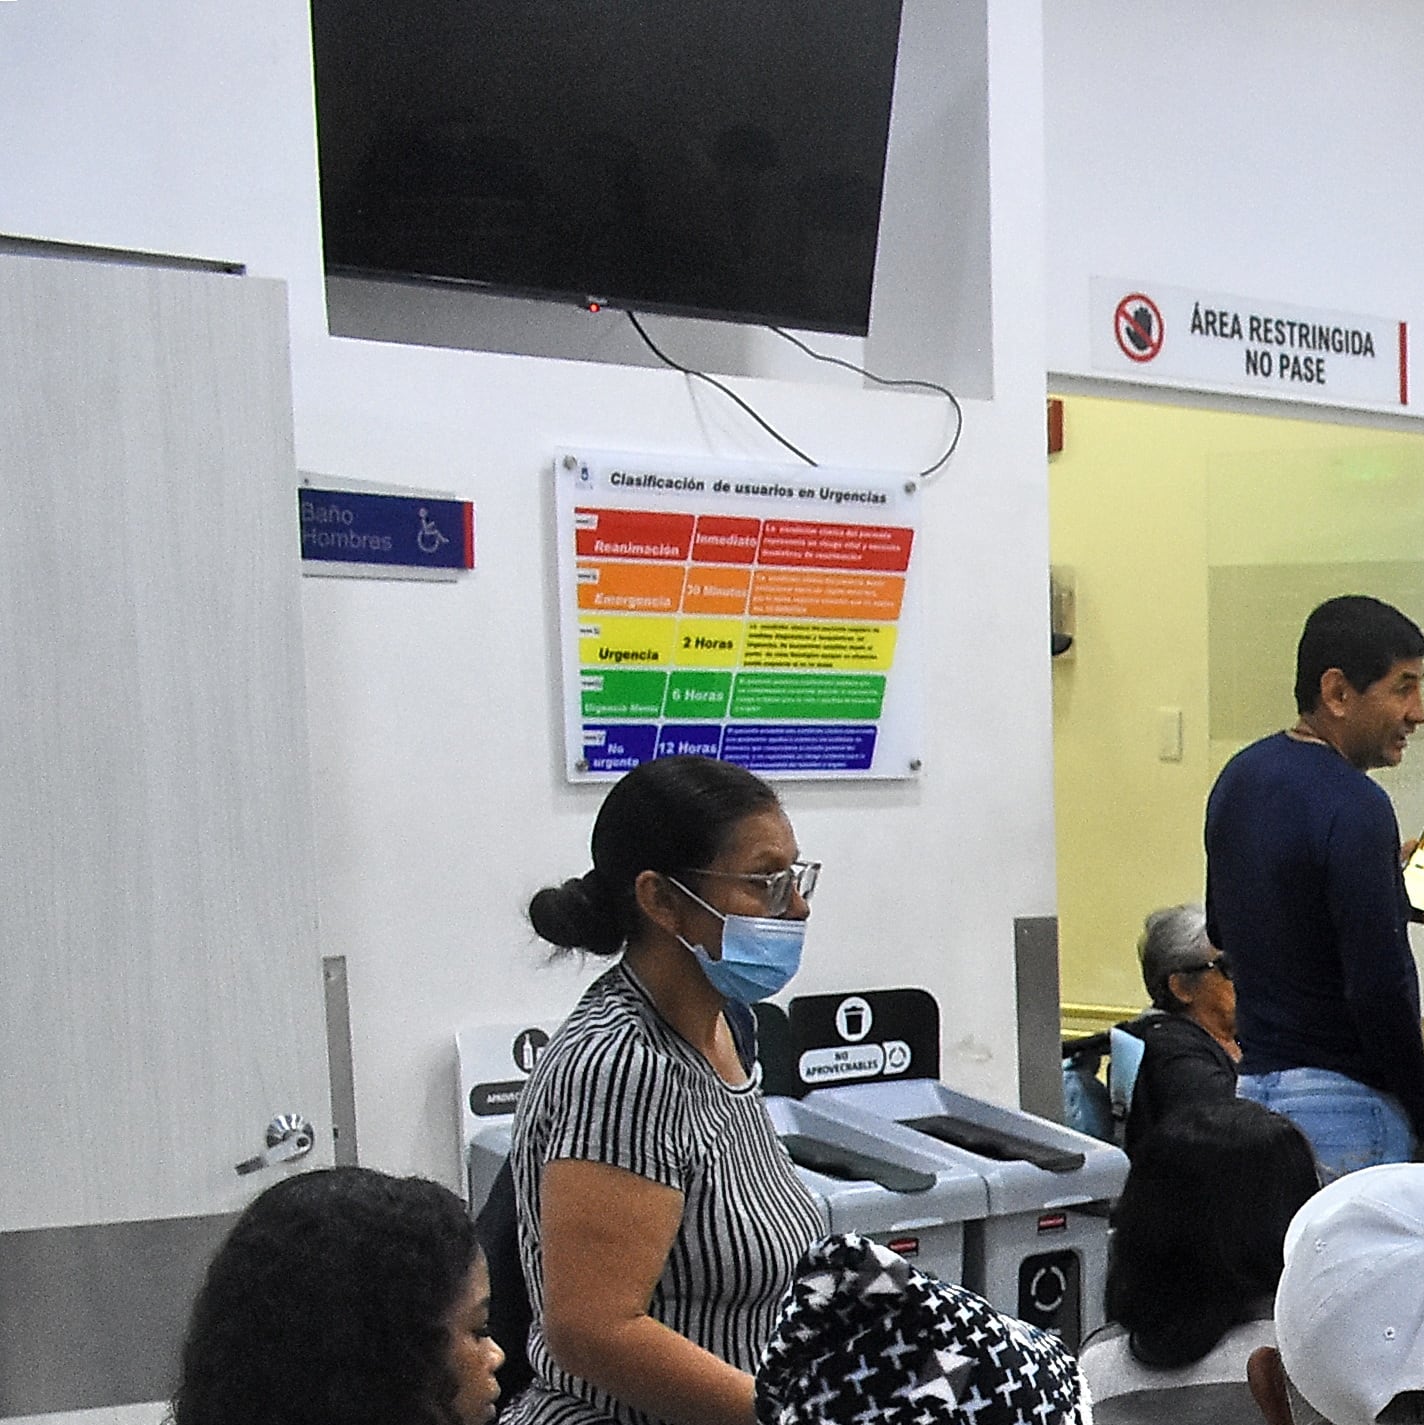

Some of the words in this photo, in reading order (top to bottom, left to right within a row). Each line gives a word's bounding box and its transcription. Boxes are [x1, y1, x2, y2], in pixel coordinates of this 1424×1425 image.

[1190, 300, 1243, 341] ÁREA
[1248, 314, 1376, 358] RESTRINGIDA
[1244, 349, 1273, 379] NO
[1278, 353, 1326, 384] PASE
[610, 471, 705, 492] Clasificación
[713, 479, 730, 493] de
[734, 482, 794, 498] usuarios
[798, 489, 815, 499] en
[819, 487, 888, 504] Urgencias
[301, 501, 354, 526] Baño
[302, 527, 393, 551] Hombres
[695, 533, 757, 548] Inmediato
[593, 539, 680, 557] Reanimación
[682, 637, 692, 649] 2
[694, 637, 734, 650] Horas
[598, 647, 660, 663] Urgencia
[671, 688, 682, 701] 6
[684, 688, 725, 702] Horas
[607, 743, 625, 754] No
[658, 742, 674, 754] 12
[678, 741, 718, 754] Horas
[593, 757, 640, 769] urgente
[834, 1050, 849, 1061] NO
